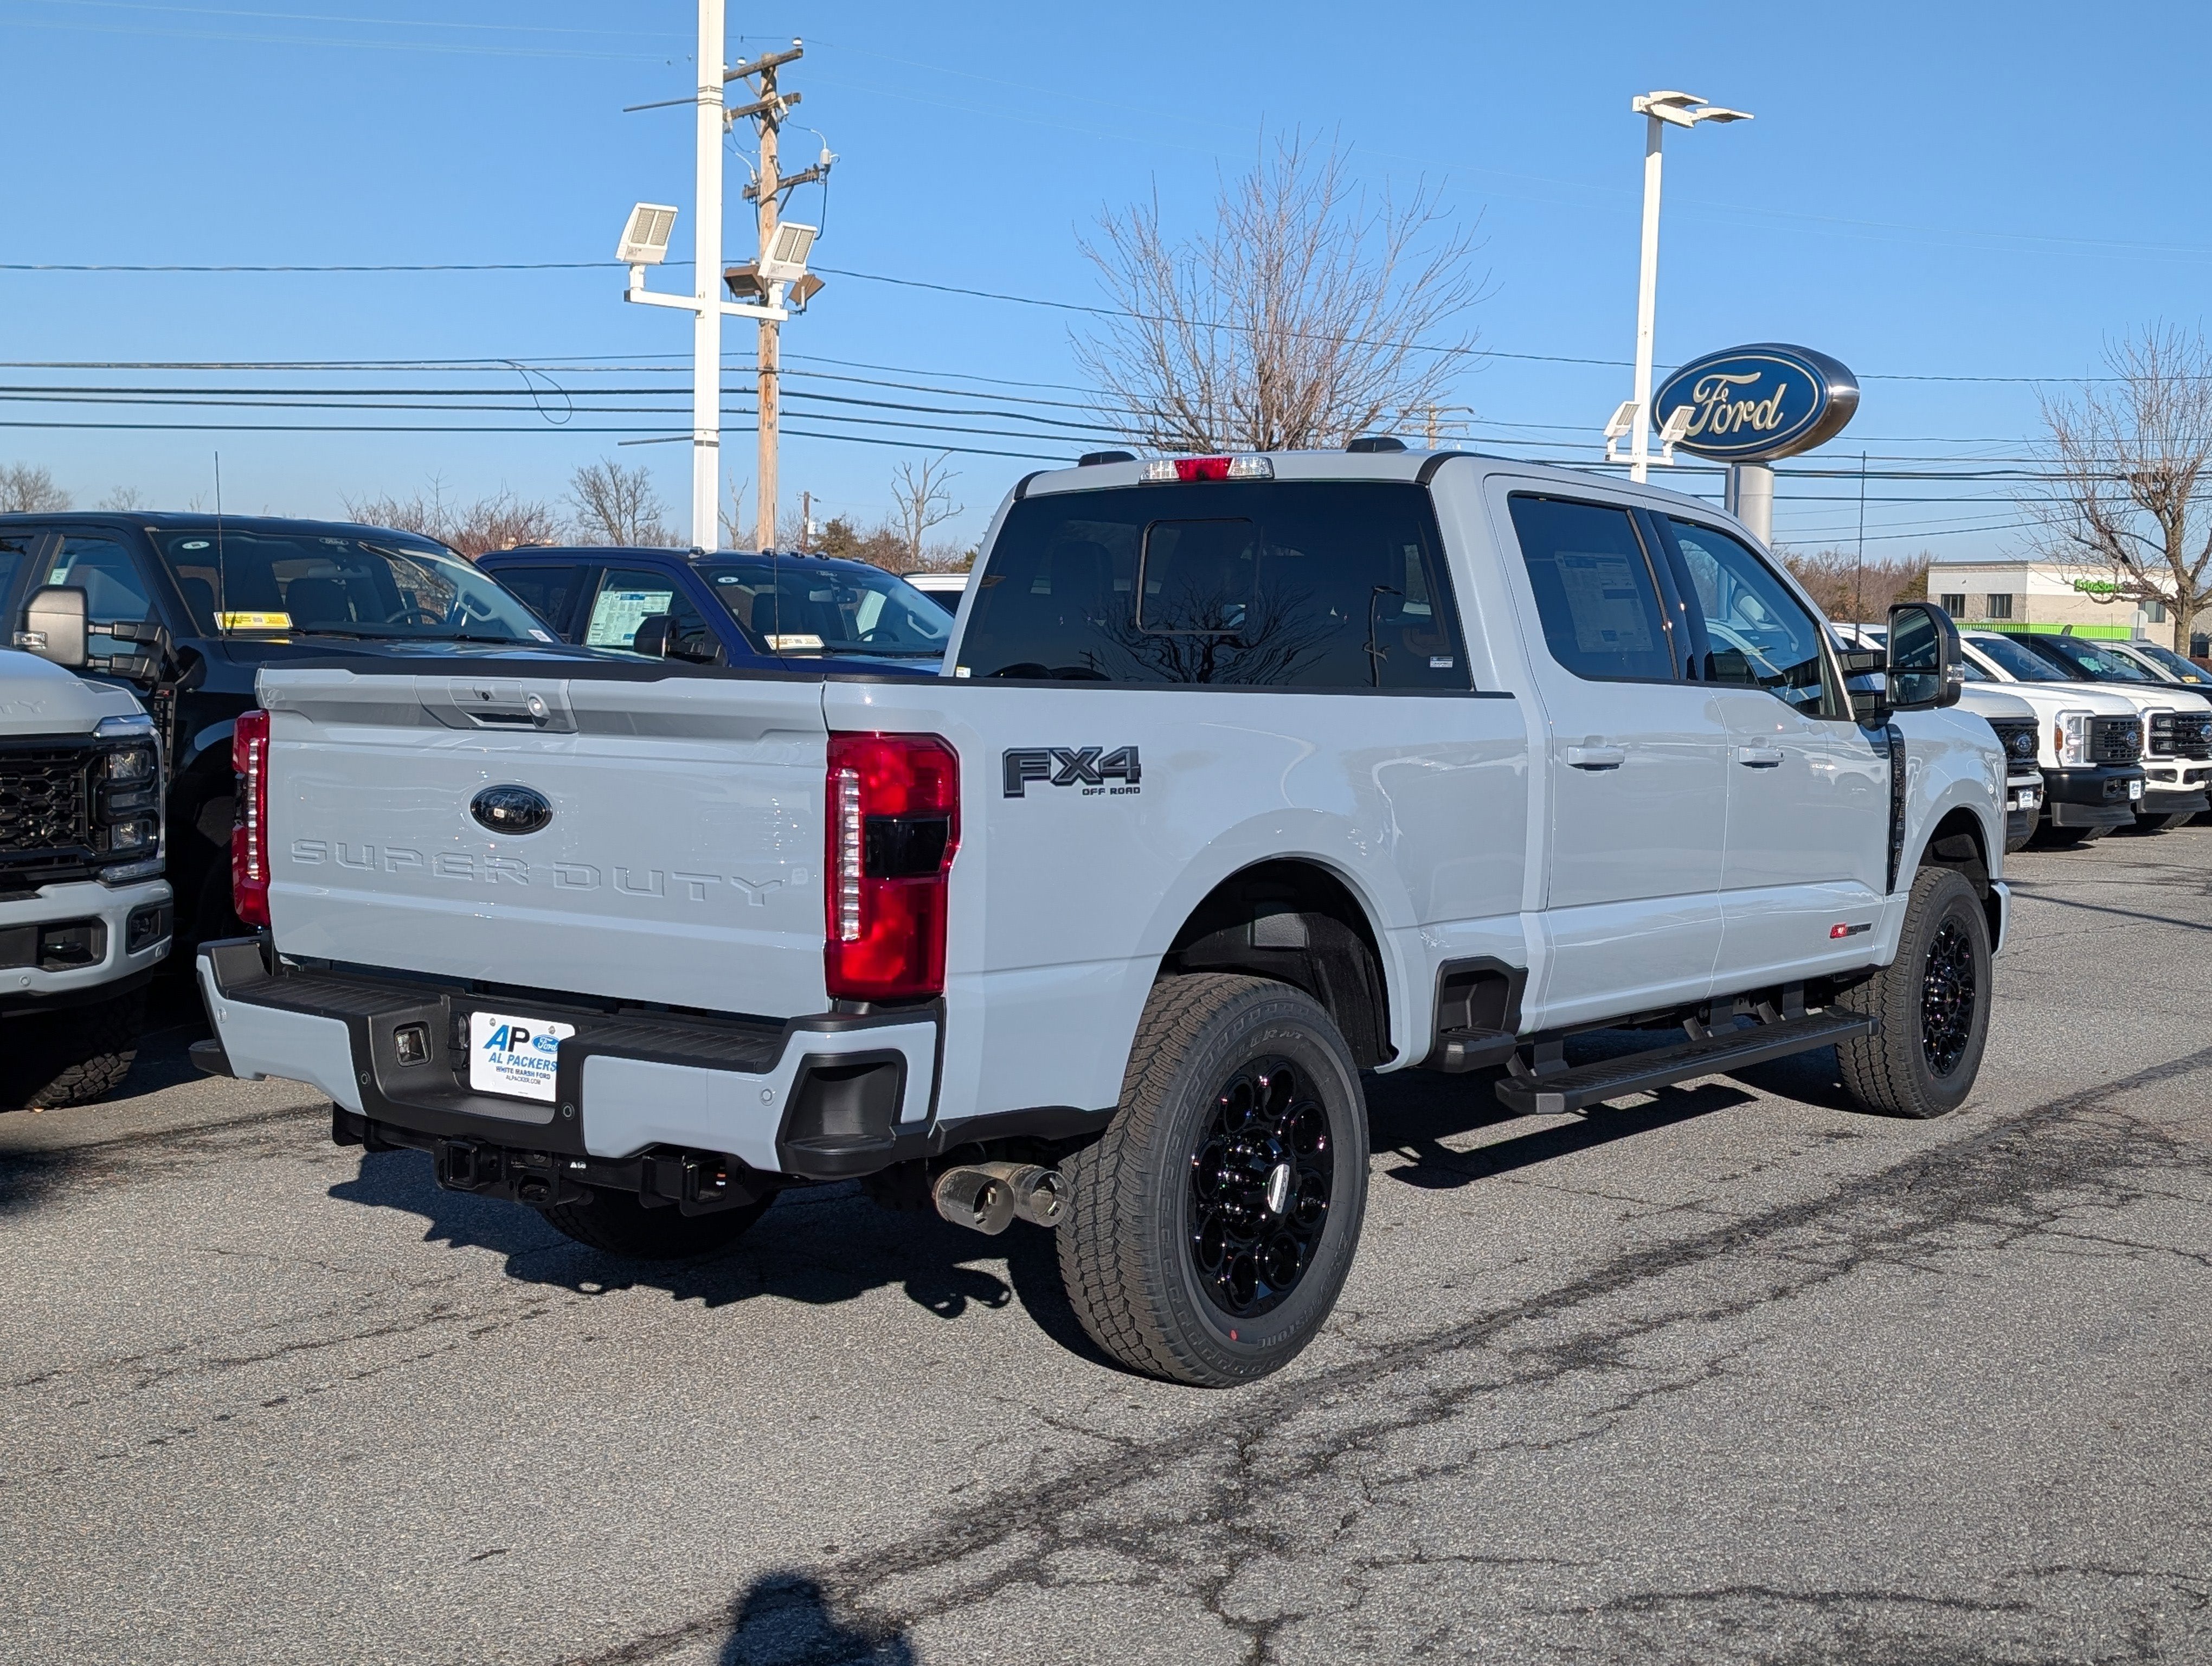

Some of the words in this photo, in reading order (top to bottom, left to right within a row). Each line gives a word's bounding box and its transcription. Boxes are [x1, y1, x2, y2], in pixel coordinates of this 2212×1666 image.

[1686, 372, 1787, 437] Ford
[1002, 745, 1141, 798] FX4
[1082, 788, 1105, 796] OFF
[1109, 787, 1141, 795] ROAD
[291, 838, 529, 886] SUPER
[553, 861, 783, 907] DUTY
[483, 1024, 530, 1052] AP
[537, 1036, 558, 1052] Ford
[488, 1052, 503, 1064] AL
[506, 1054, 558, 1072] PACKERS
